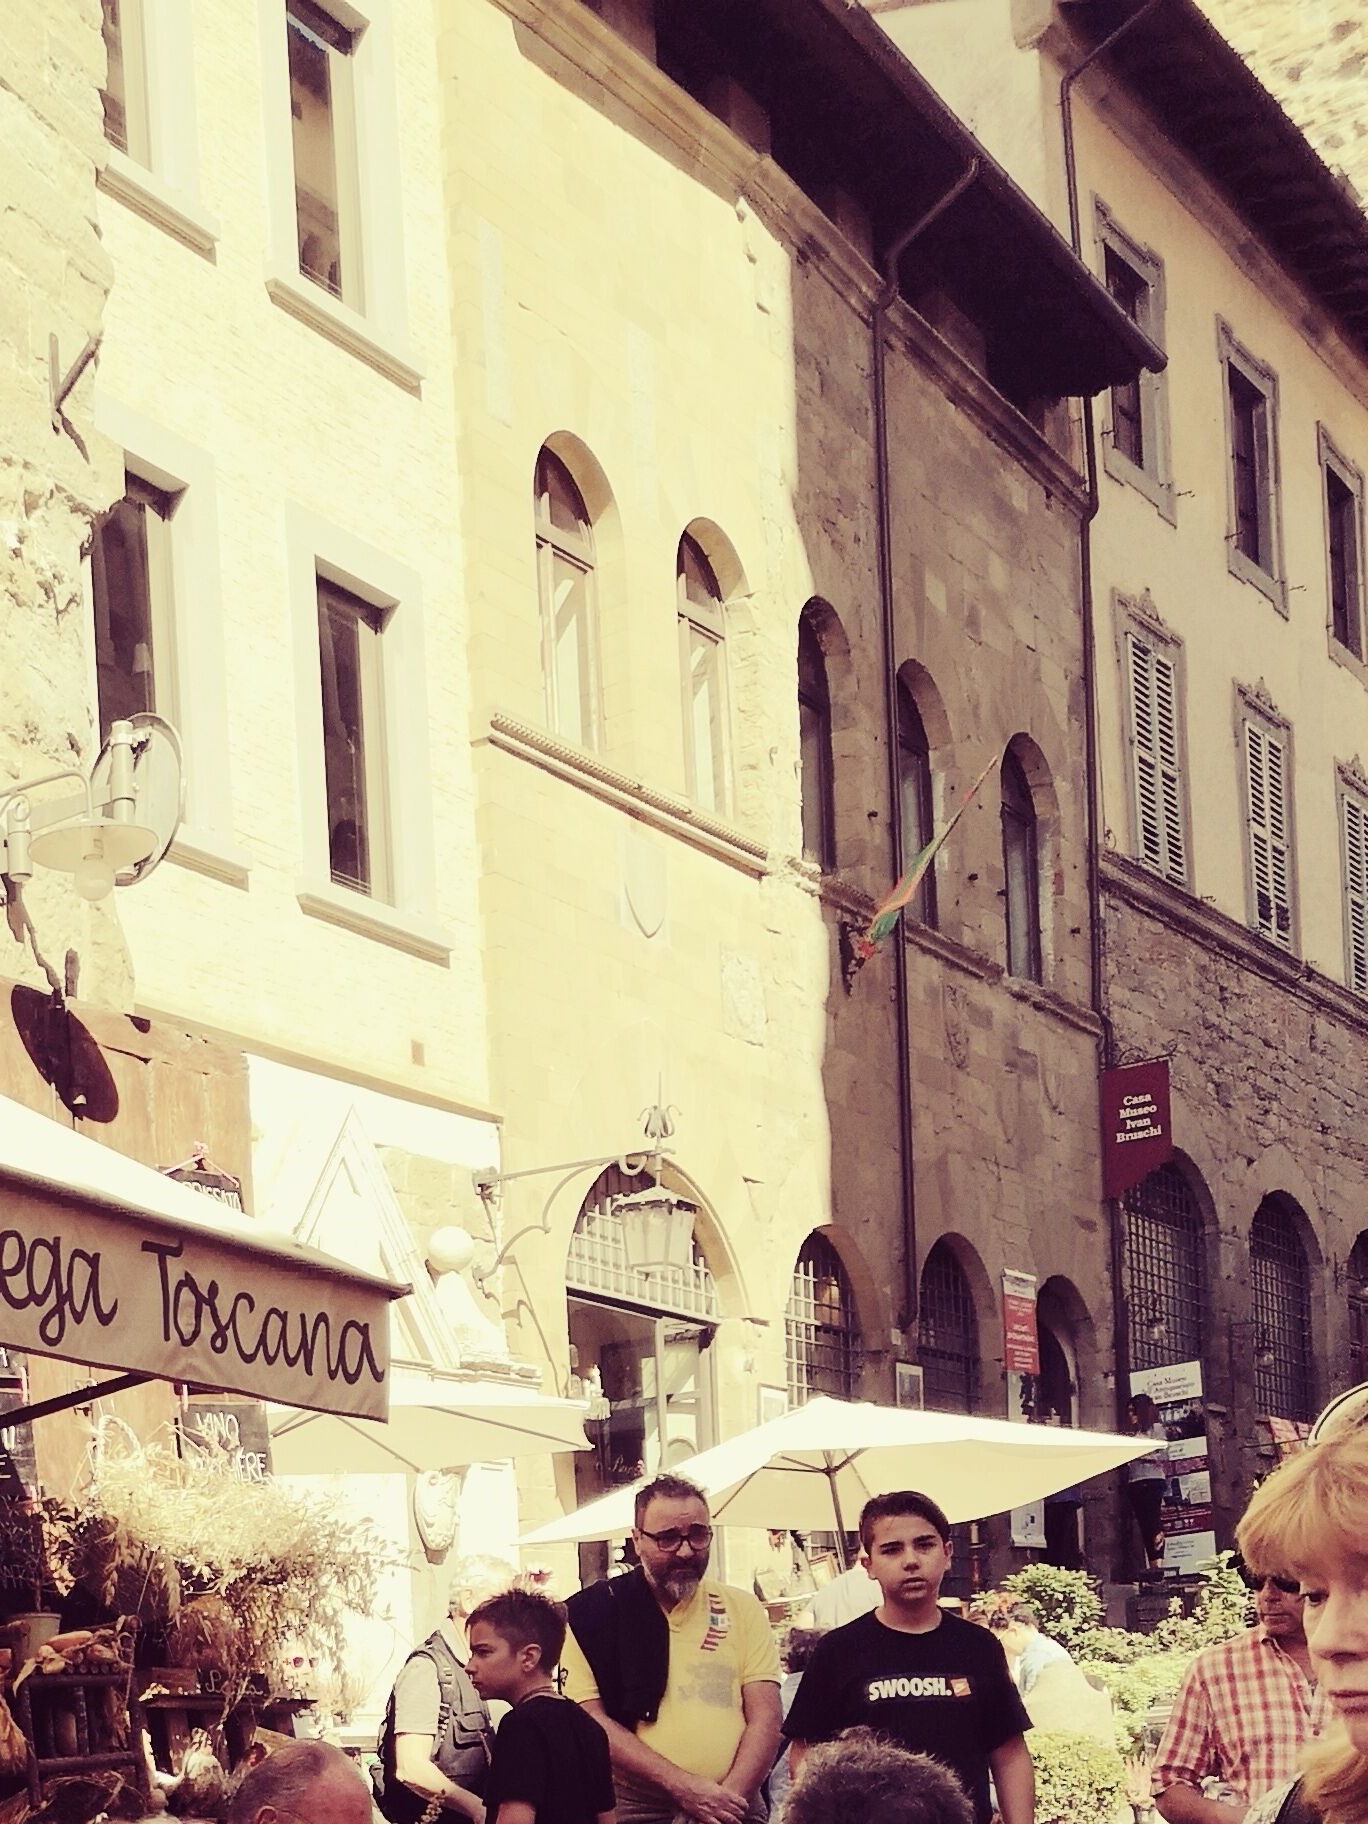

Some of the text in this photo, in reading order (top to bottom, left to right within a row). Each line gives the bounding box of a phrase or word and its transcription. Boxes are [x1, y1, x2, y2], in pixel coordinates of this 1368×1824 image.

[1123, 1094, 1152, 1106] Casa
[1119, 1105, 1158, 1119] Museo
[1126, 1118, 1151, 1130] Ivan
[1116, 1125, 1162, 1143] Bruschi
[141, 1241, 385, 1385] Toscana
[868, 1677, 953, 1701] SWOOSH.
